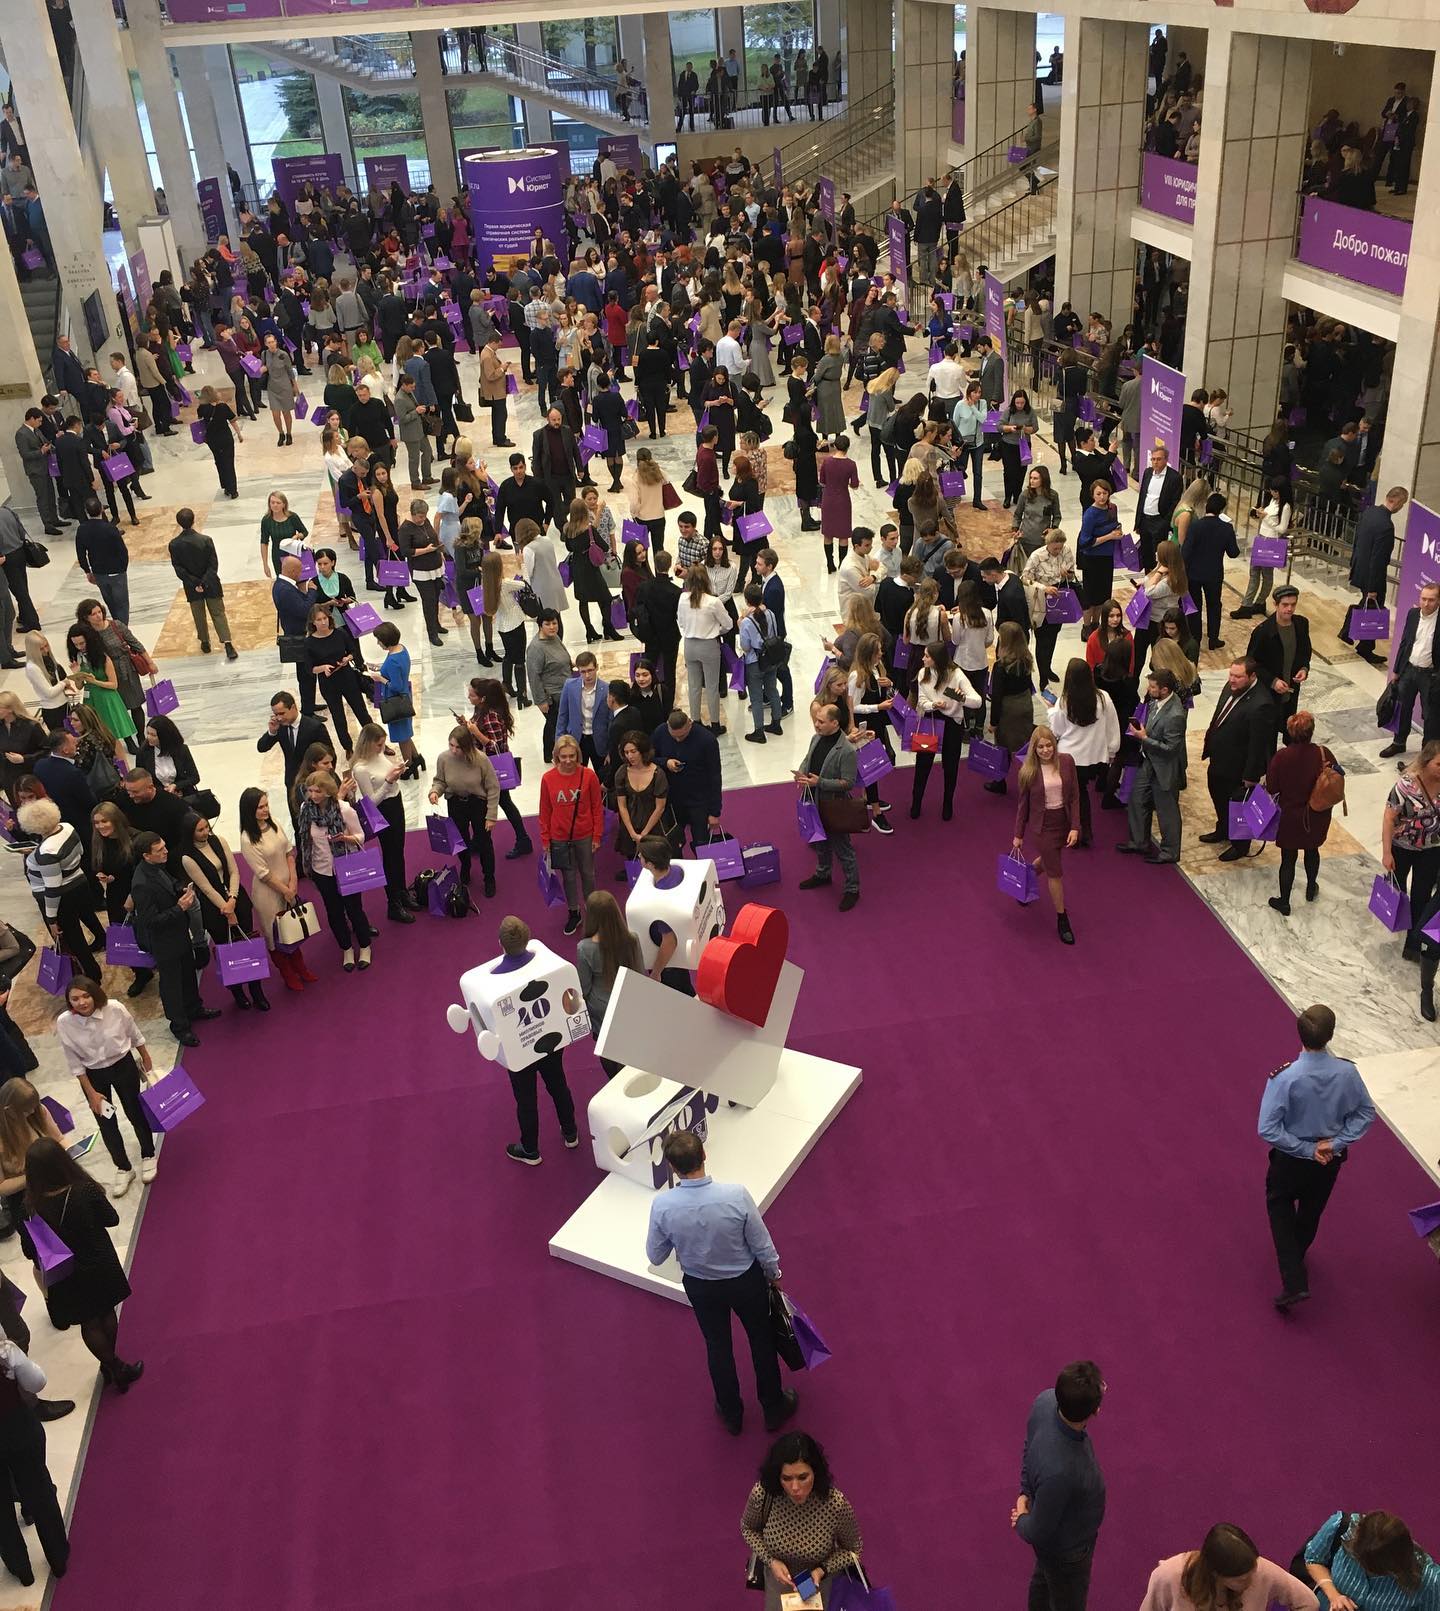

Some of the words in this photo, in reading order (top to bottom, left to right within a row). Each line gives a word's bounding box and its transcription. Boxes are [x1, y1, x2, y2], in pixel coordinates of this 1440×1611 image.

[525, 173, 552, 183] Система
[526, 183, 549, 193] Юрист
[1176, 194, 1188, 207] ДЛЯ
[1332, 229, 1369, 256] Добро
[1370, 244, 1408, 268] пожал
